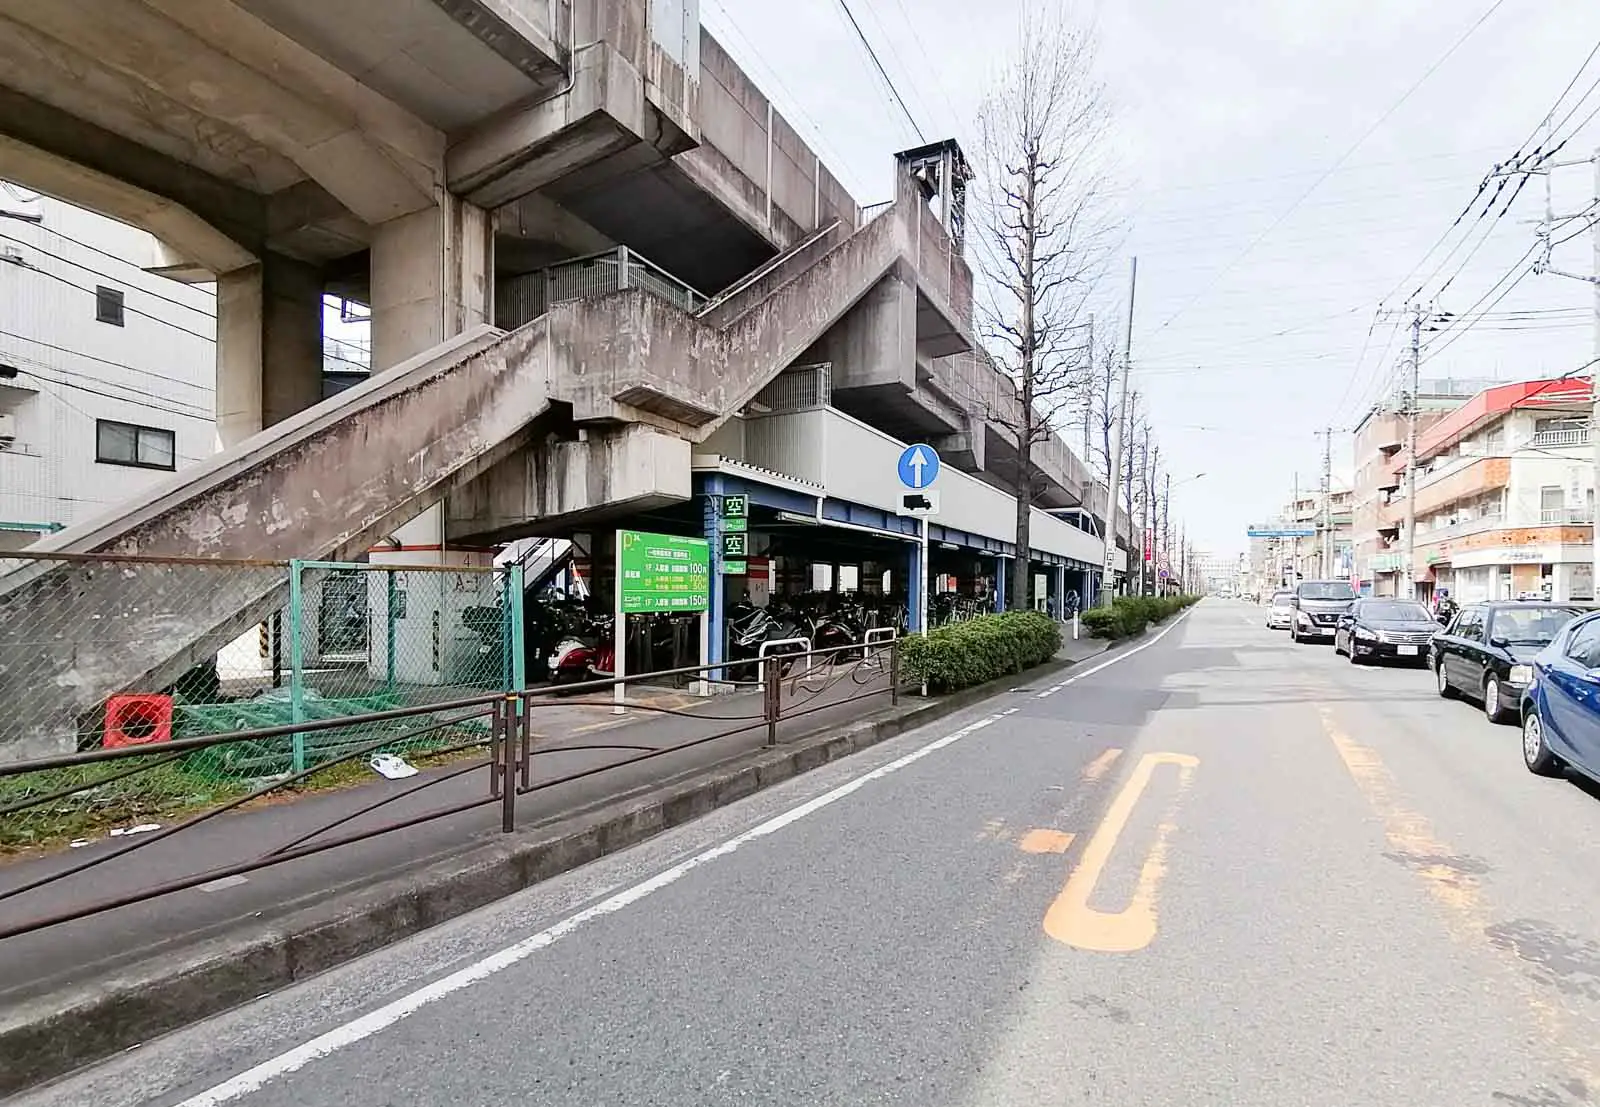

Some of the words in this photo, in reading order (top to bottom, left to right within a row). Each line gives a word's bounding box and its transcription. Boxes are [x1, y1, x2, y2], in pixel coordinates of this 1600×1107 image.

[726, 496, 744, 516] 空
[725, 536, 743, 555] 空
[463, 552, 472, 568] 4
